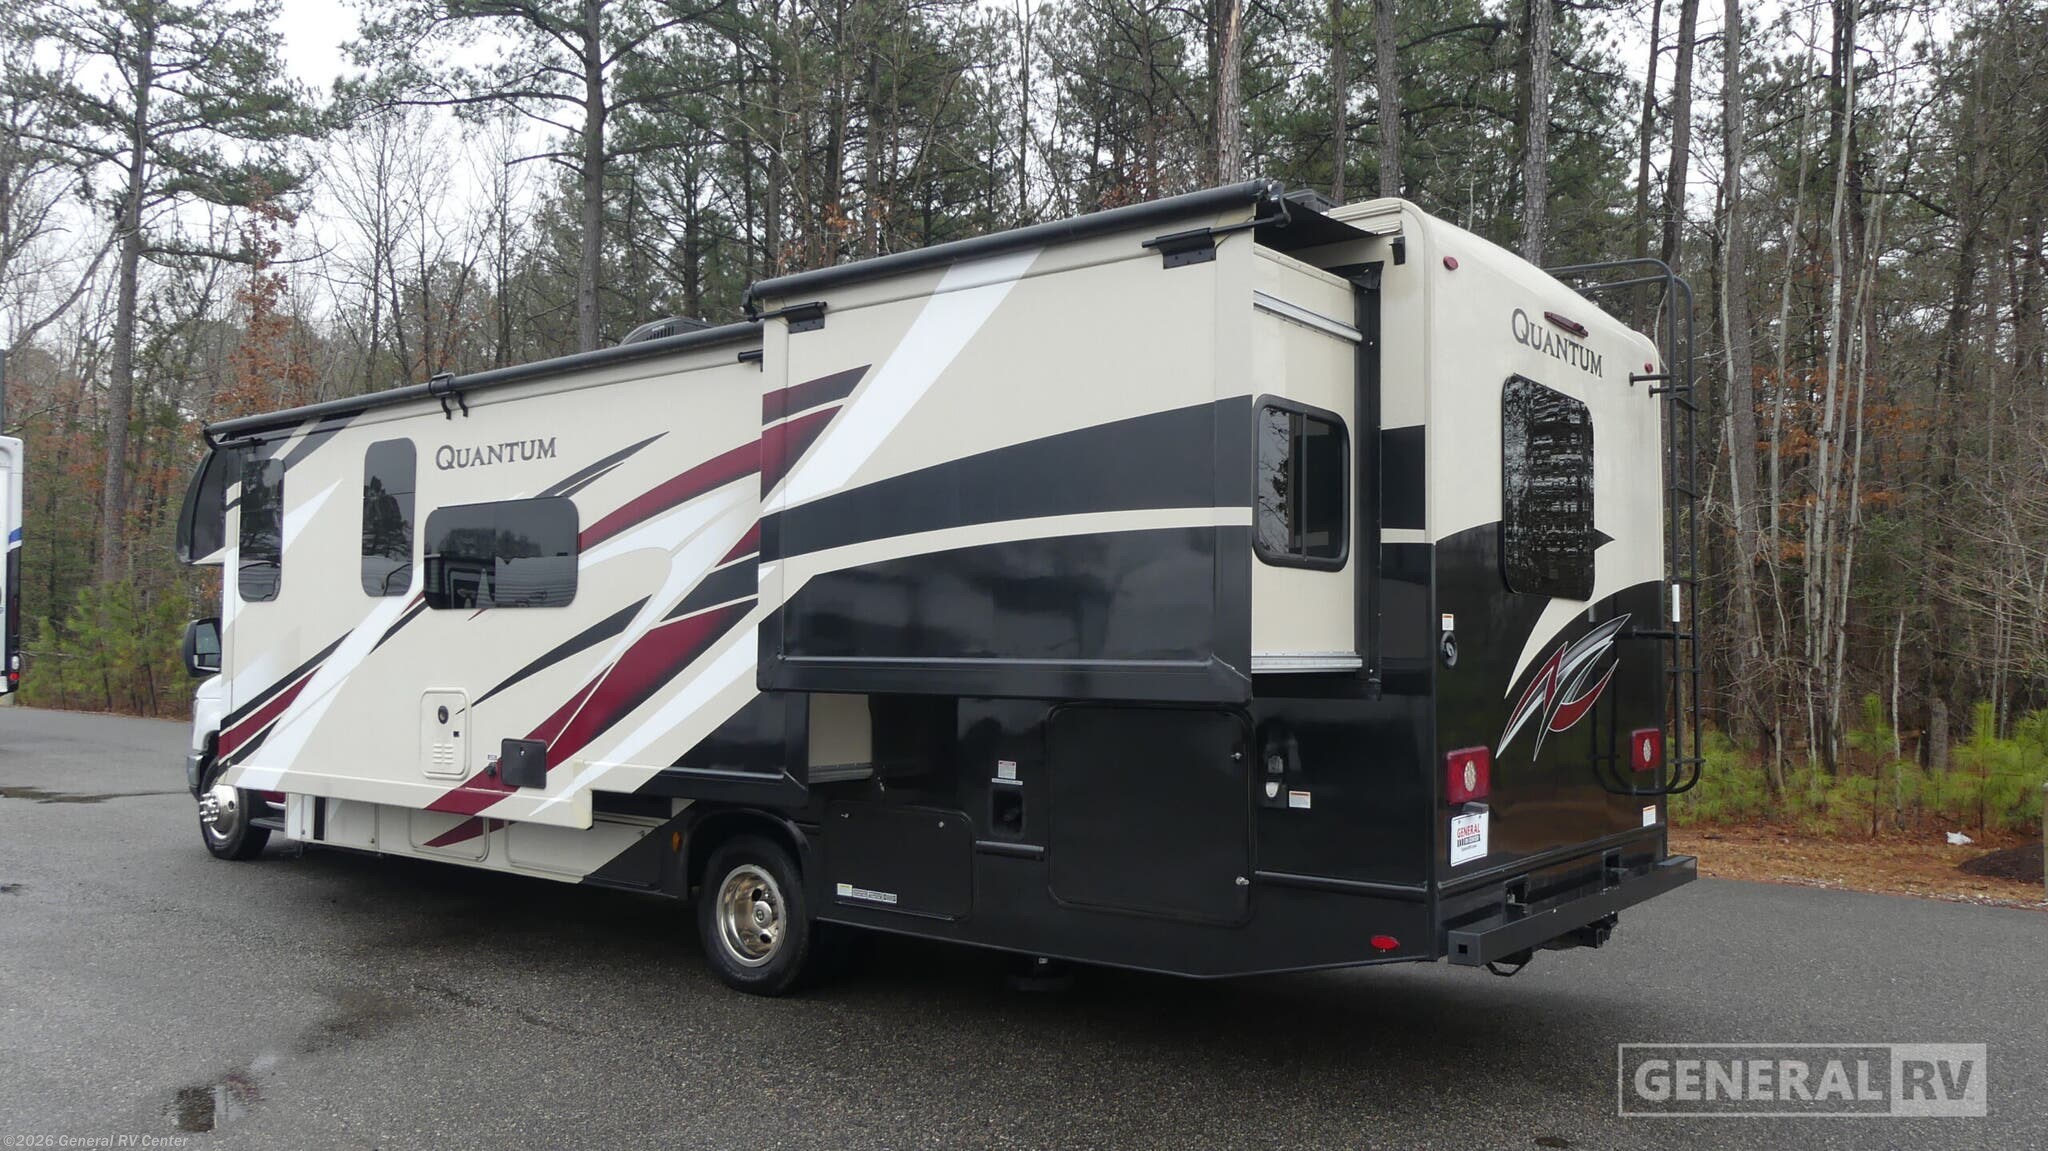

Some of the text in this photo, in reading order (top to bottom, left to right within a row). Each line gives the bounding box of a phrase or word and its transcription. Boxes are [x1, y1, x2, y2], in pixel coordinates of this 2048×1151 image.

[1512, 308, 1603, 377] QUANTUM
[436, 437, 557, 470] QUANTUM
[1457, 823, 1480, 838] GENERAL
